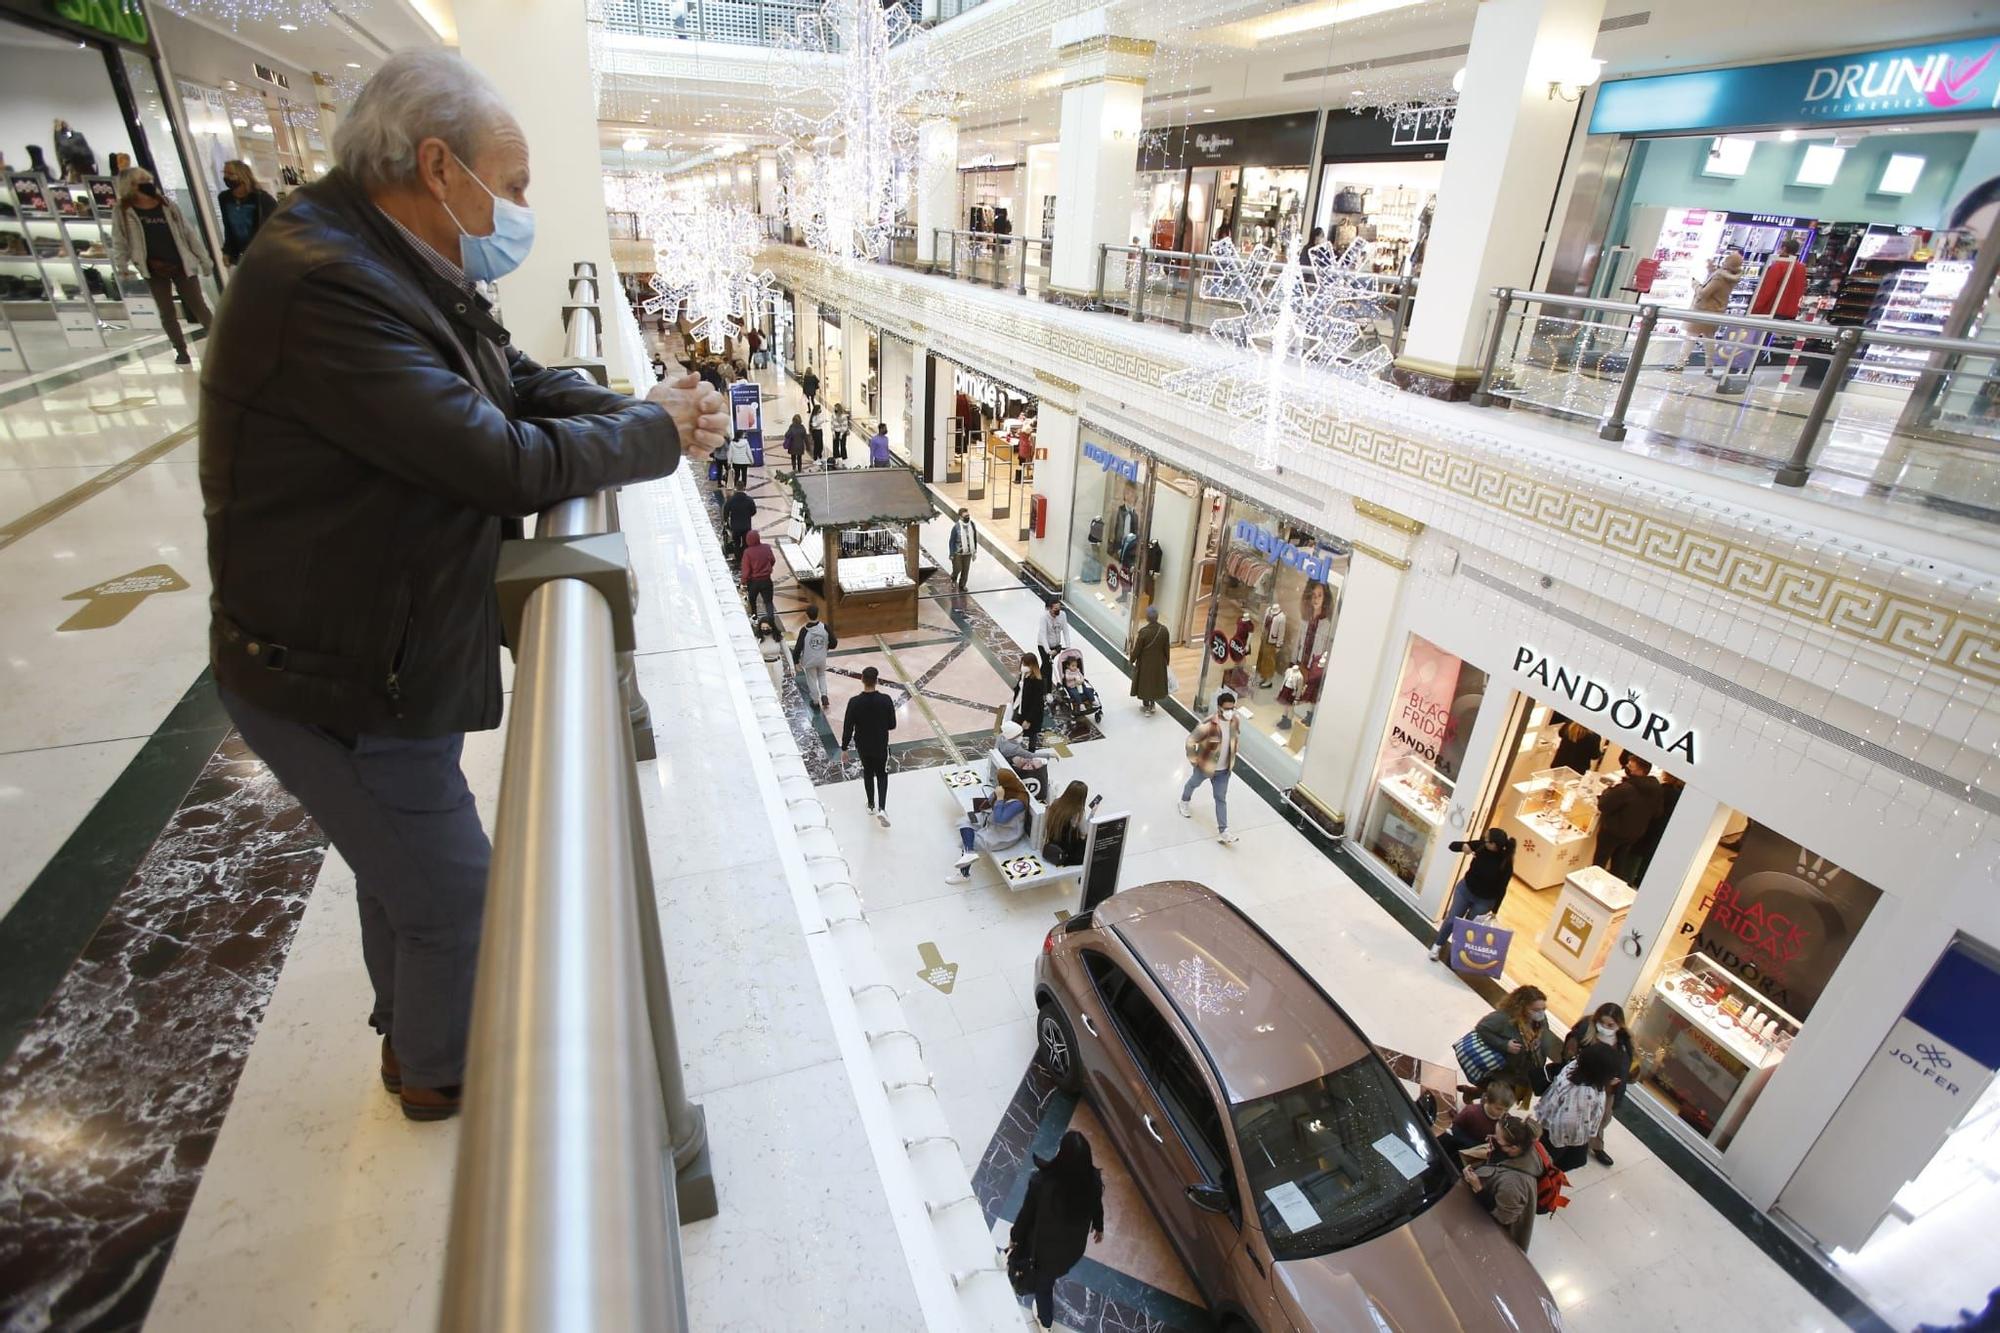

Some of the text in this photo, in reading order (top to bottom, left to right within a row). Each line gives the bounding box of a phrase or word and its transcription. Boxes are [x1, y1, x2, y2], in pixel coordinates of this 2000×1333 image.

[1804, 53, 1950, 102] DRUNI
[1752, 214, 1796, 227] MAYBELLINE
[954, 369, 997, 409] pimkie
[1083, 442, 1139, 483] mayoral
[1235, 519, 1333, 585] mayoral
[1212, 641, 1226, 659] 20
[1402, 705, 1456, 745] FRIDAY
[1409, 692, 1459, 733] BLACK
[1512, 645, 1696, 766] PANDORA
[1392, 726, 1452, 774] PANDORA
[1698, 895, 1799, 964] FRIDAY
[1713, 879, 1809, 950] BLACK
[1680, 921, 1790, 1006] PANDORA
[1888, 1048, 1960, 1096] JOLFER
